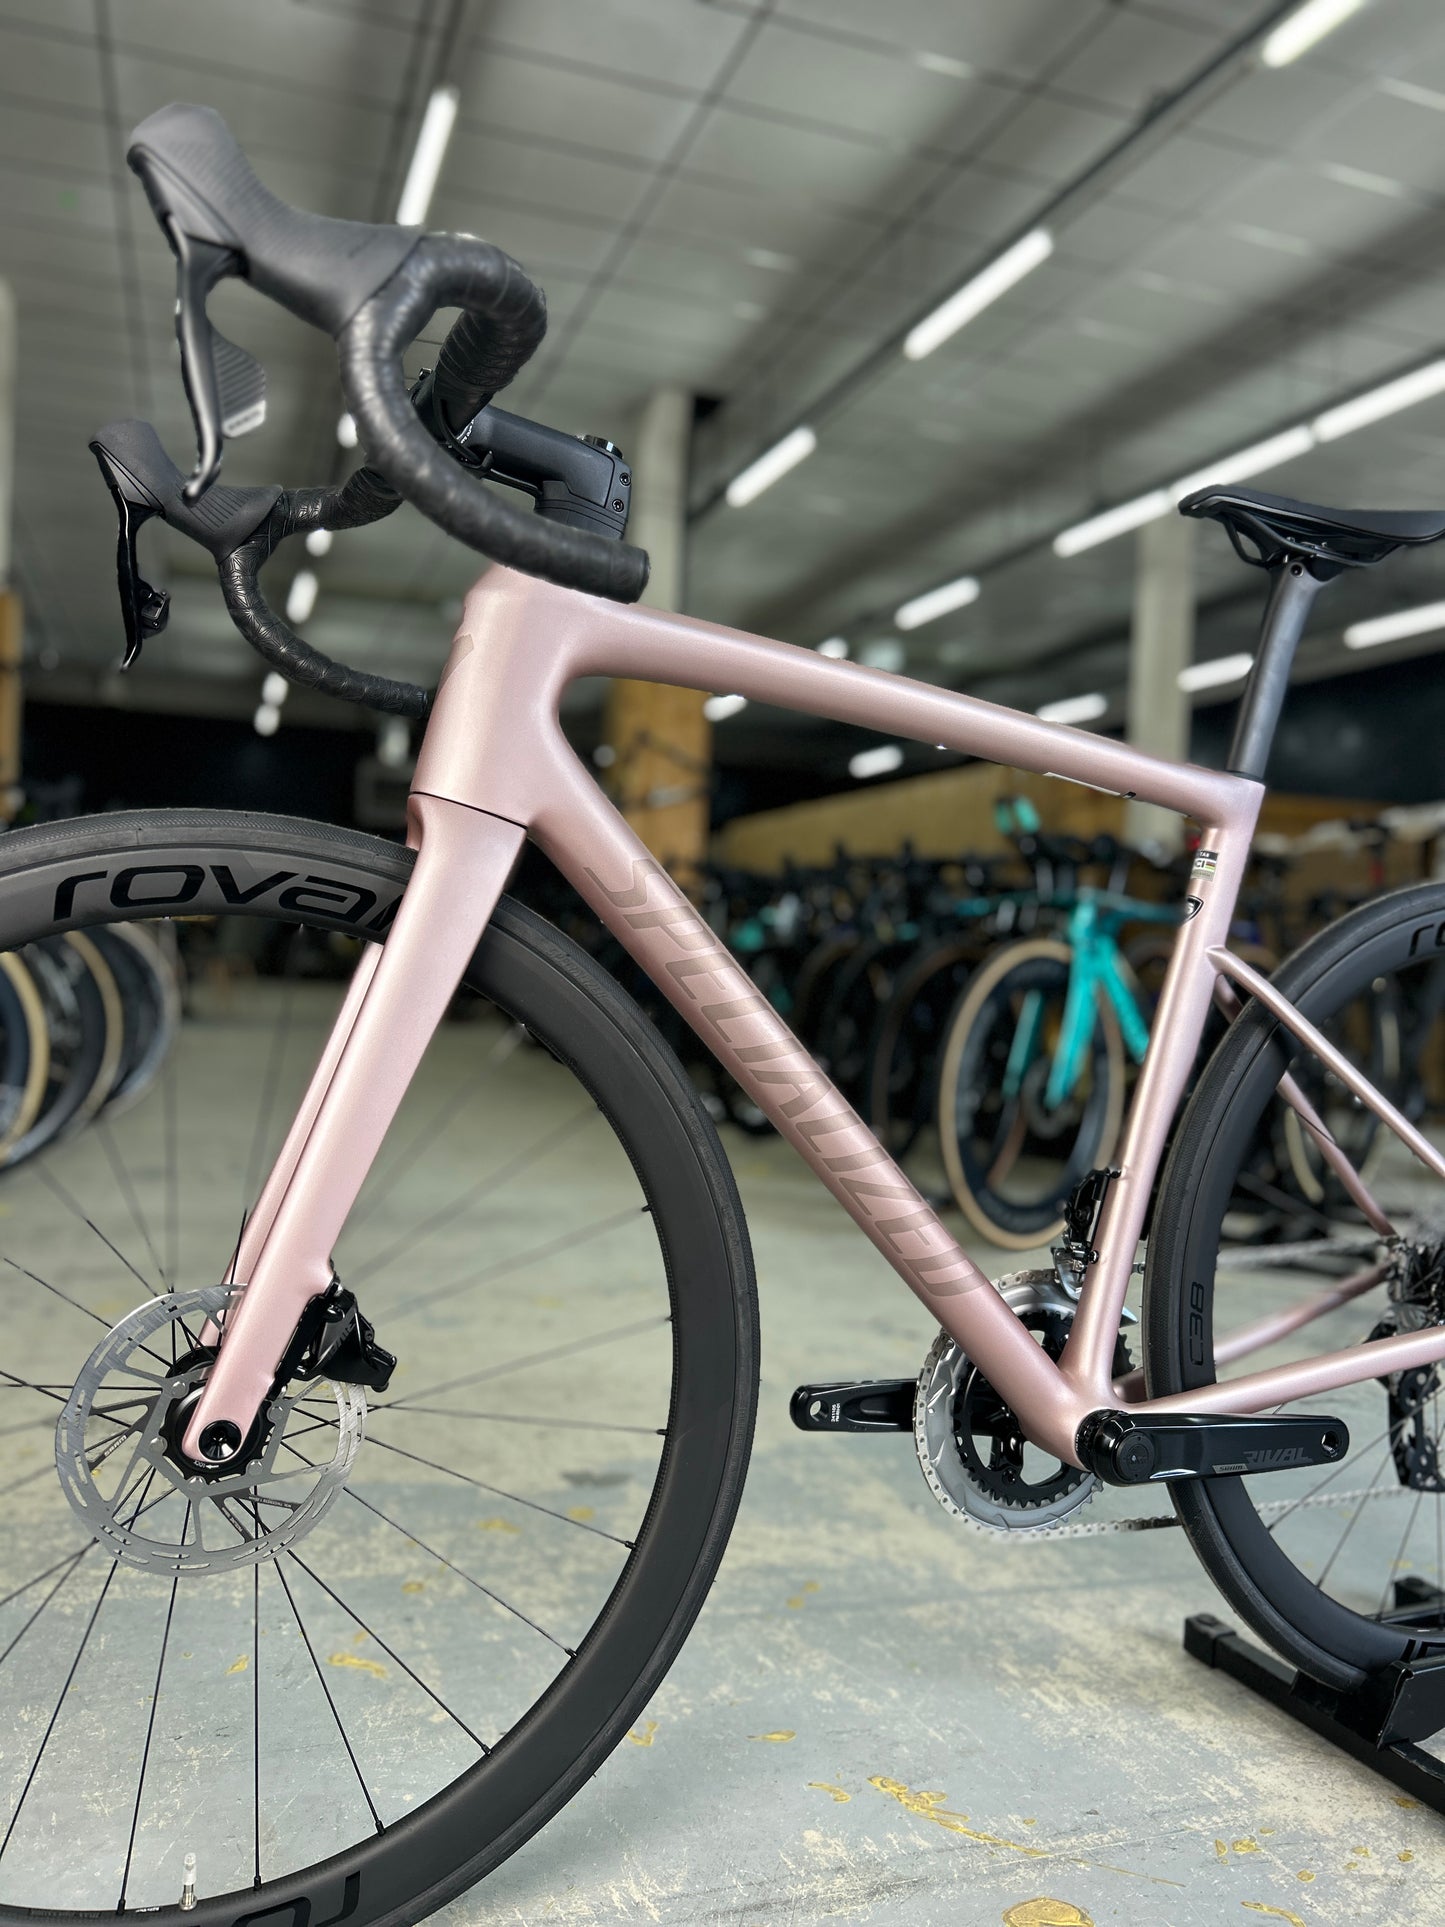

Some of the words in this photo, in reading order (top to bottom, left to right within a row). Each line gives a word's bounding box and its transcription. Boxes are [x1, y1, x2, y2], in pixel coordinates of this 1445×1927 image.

[583, 858, 987, 1297] SPECIALIZED
[1189, 1281, 1205, 1367] C38
[1242, 1447, 1315, 1465] RIVAL
